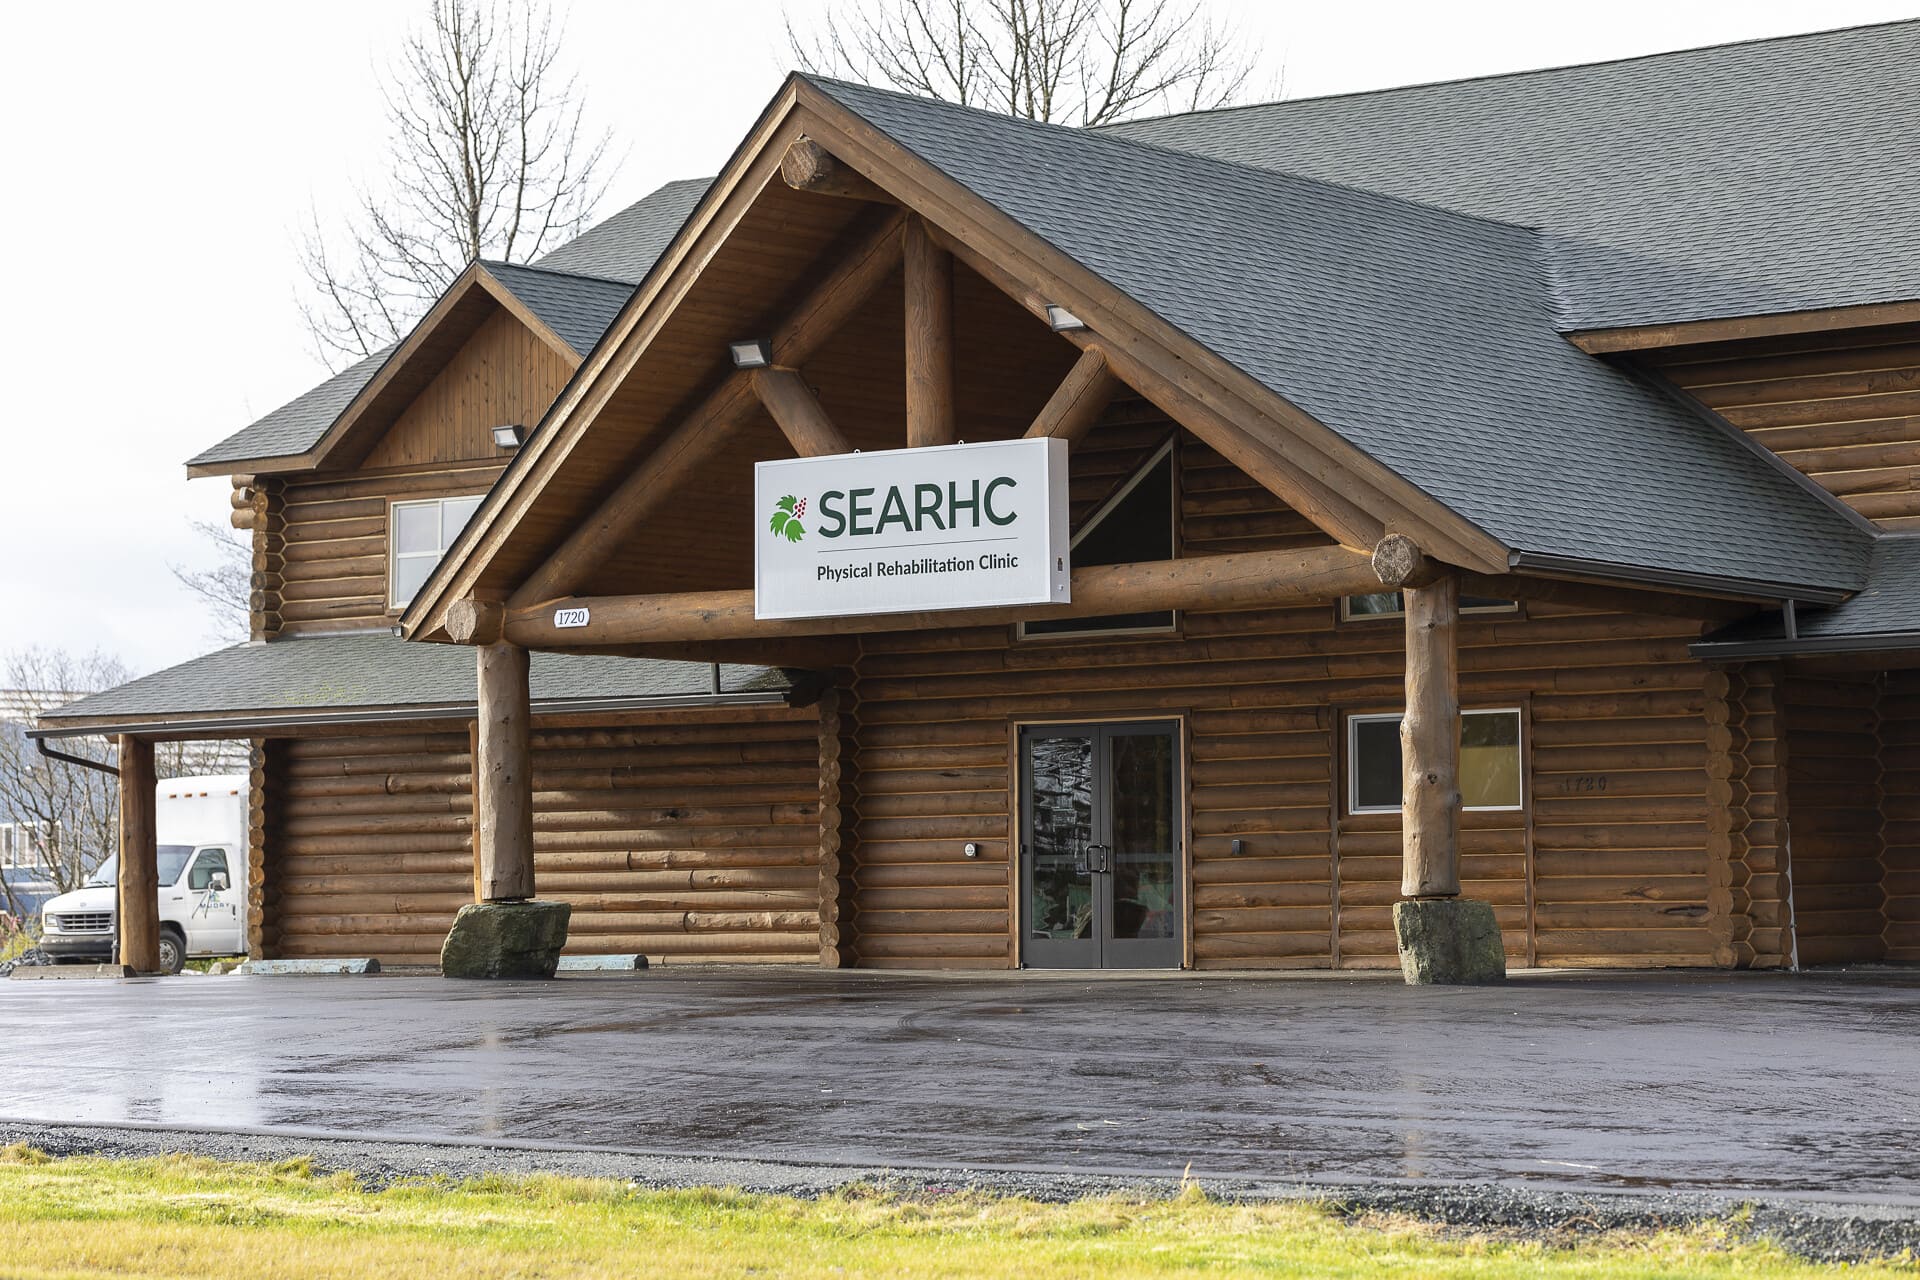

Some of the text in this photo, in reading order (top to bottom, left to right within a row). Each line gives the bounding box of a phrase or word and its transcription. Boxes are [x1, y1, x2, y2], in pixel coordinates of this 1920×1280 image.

[818, 476, 1018, 538] SEARHC
[817, 553, 1018, 582] Physical Rehabilitation Clinic
[558, 610, 585, 625] 1720
